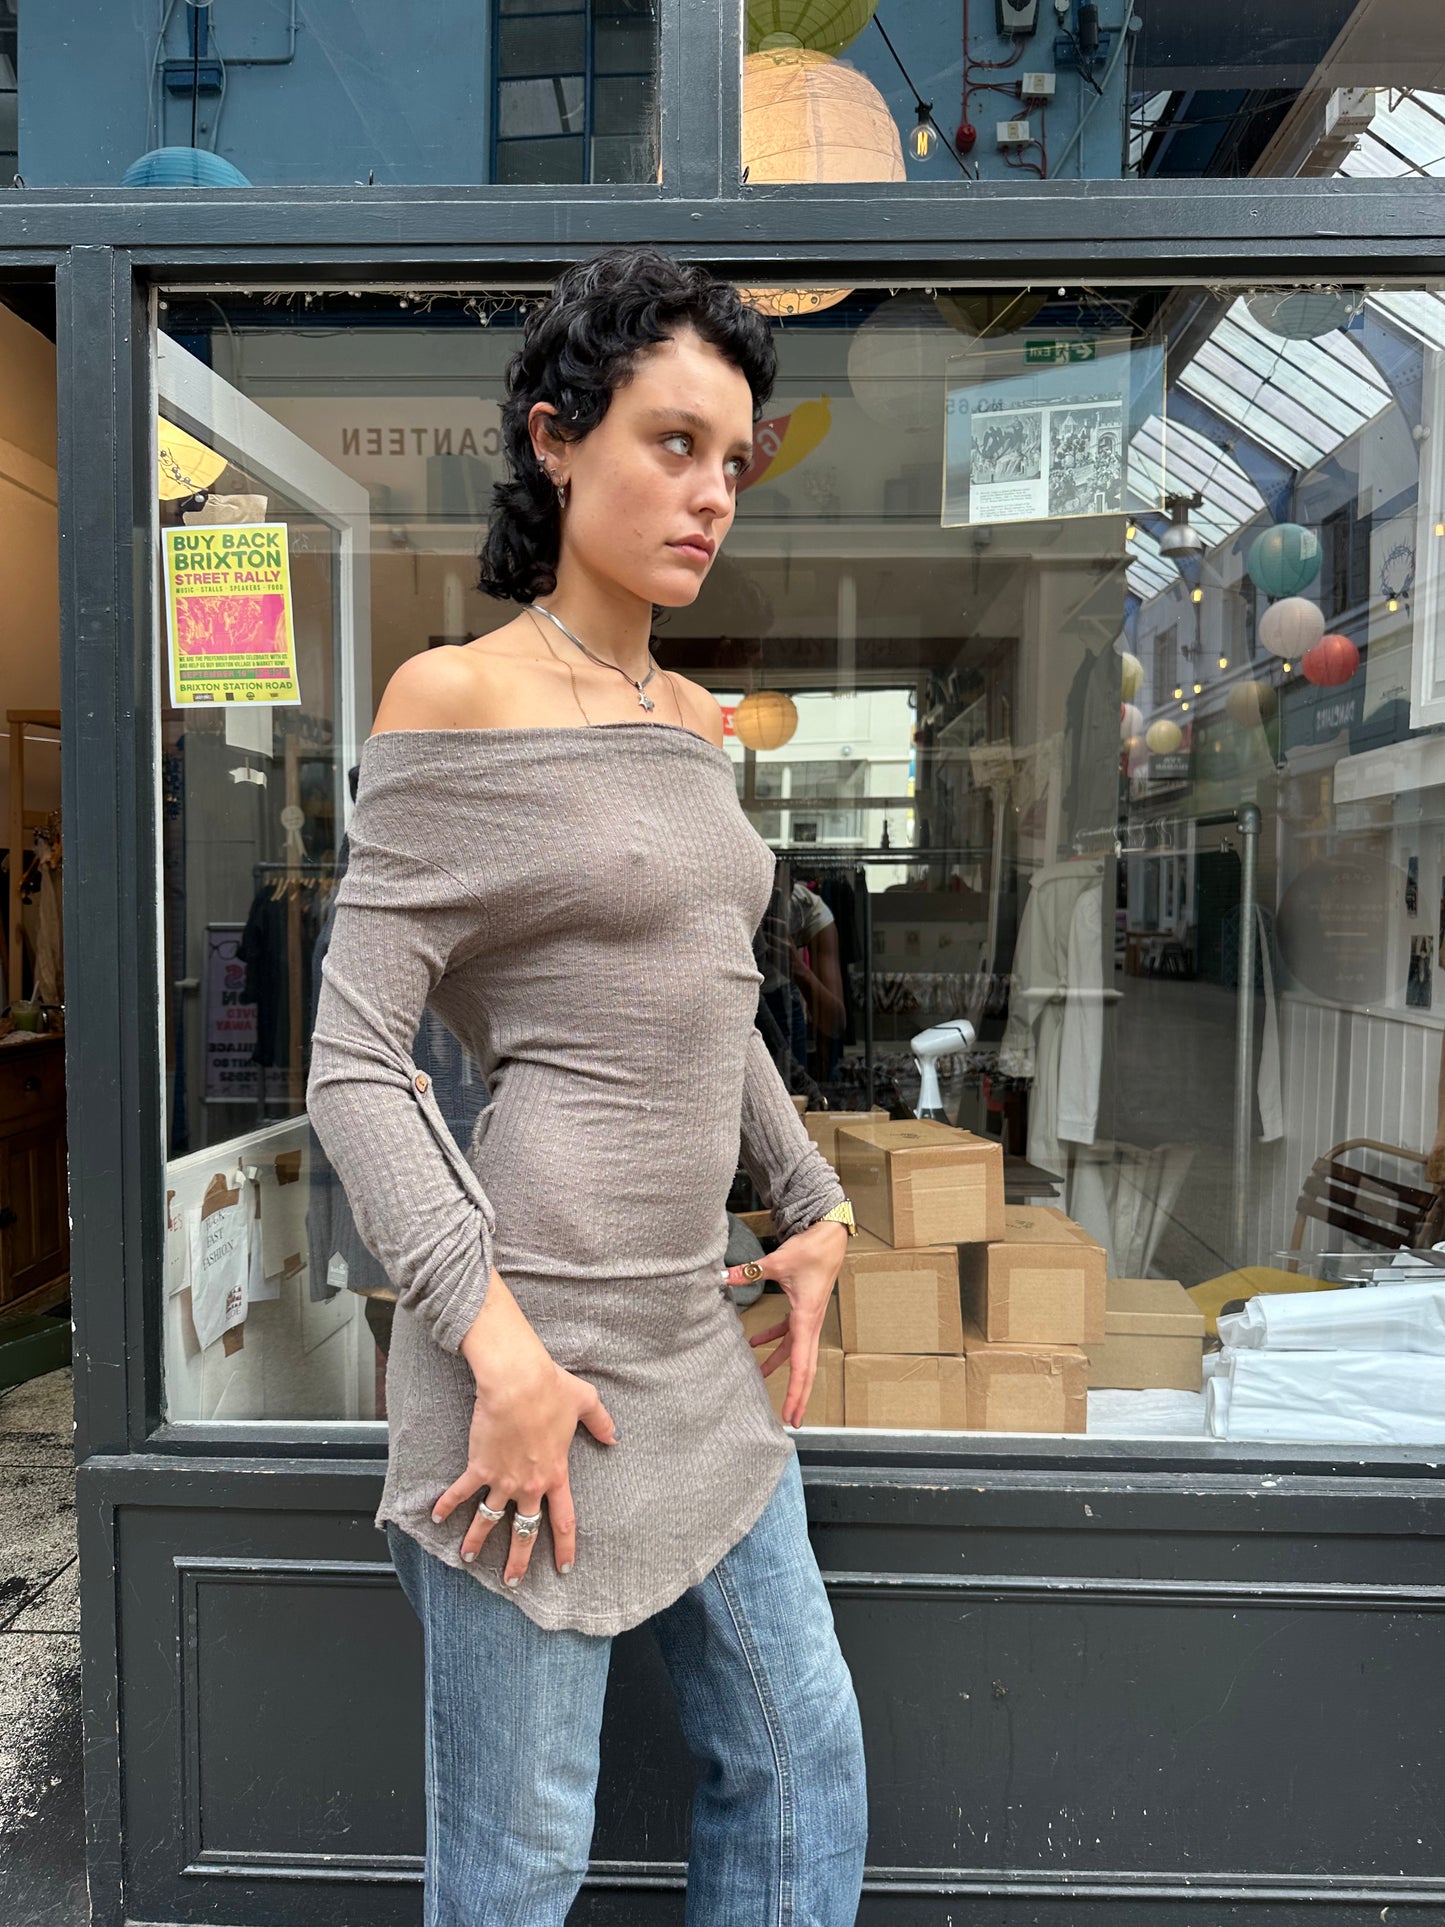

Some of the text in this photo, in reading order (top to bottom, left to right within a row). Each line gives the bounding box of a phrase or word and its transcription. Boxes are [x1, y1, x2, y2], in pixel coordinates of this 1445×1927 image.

[174, 535, 215, 551] BUY
[222, 532, 280, 549] BACK
[174, 549, 282, 571] BRIXTON
[175, 570, 281, 586] STREET RALLY
[175, 583, 284, 594] MUSIC STALLS SPEAKERS FOOD
[180, 669, 234, 679] SEPTEMBER
[179, 681, 293, 692] BRIXTON STATION ROAD
